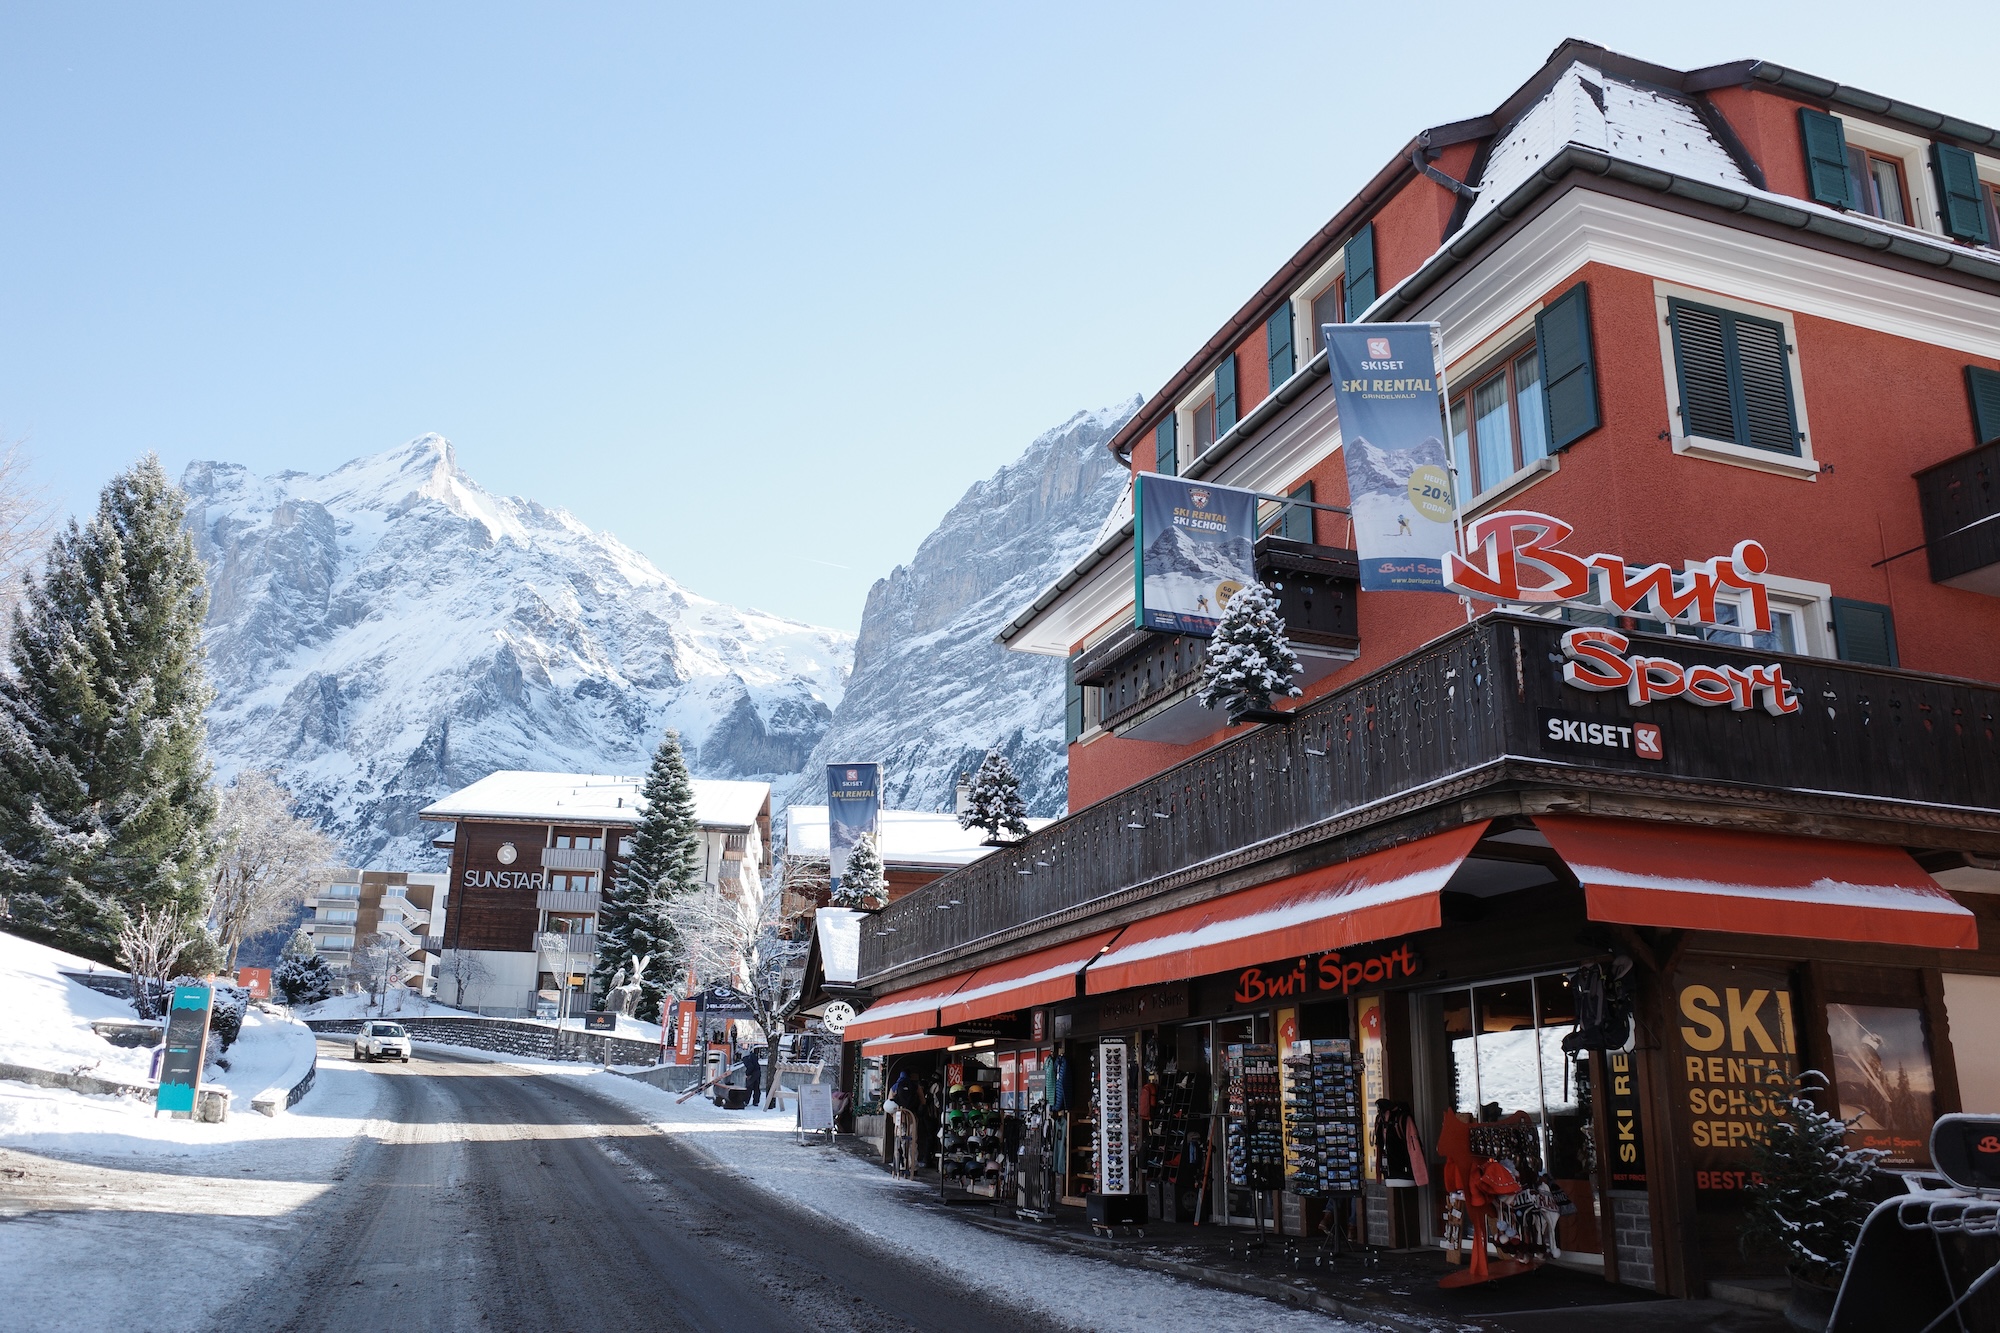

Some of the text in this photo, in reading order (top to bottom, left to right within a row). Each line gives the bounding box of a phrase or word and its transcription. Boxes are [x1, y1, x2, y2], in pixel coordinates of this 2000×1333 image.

[1361, 361, 1404, 370] SKISET
[1342, 379, 1433, 392] SKI RENTAL
[1423, 473, 1447, 487] HEUTE
[1173, 507, 1227, 524] SKI RENTAL
[1422, 501, 1446, 515] TODAY
[1173, 516, 1190, 526] SKI
[1191, 519, 1228, 533] SCHOOL
[1378, 563, 1443, 575] Buri Spo
[1442, 510, 1772, 634] Buri
[1560, 626, 1799, 717] Sport
[1548, 718, 1632, 749] SKISET
[831, 790, 875, 798] SKI RENTAL
[463, 869, 543, 889] SUNSTAR
[1235, 943, 1416, 1003] Buri Sport
[836, 1013, 843, 1021] &
[1679, 984, 1798, 1056] SKI
[1613, 1053, 1631, 1095] RE
[1365, 1047, 1377, 1173] T-SHIRTS
[1689, 1088, 1793, 1116] SCHOO
[1617, 1109, 1637, 1163] SKI
[1692, 1121, 1782, 1147] SERV
[1863, 1135, 1922, 1147] Buri Sport
[1977, 1136, 2000, 1153] B
[1697, 1171, 1745, 1190] BEST
